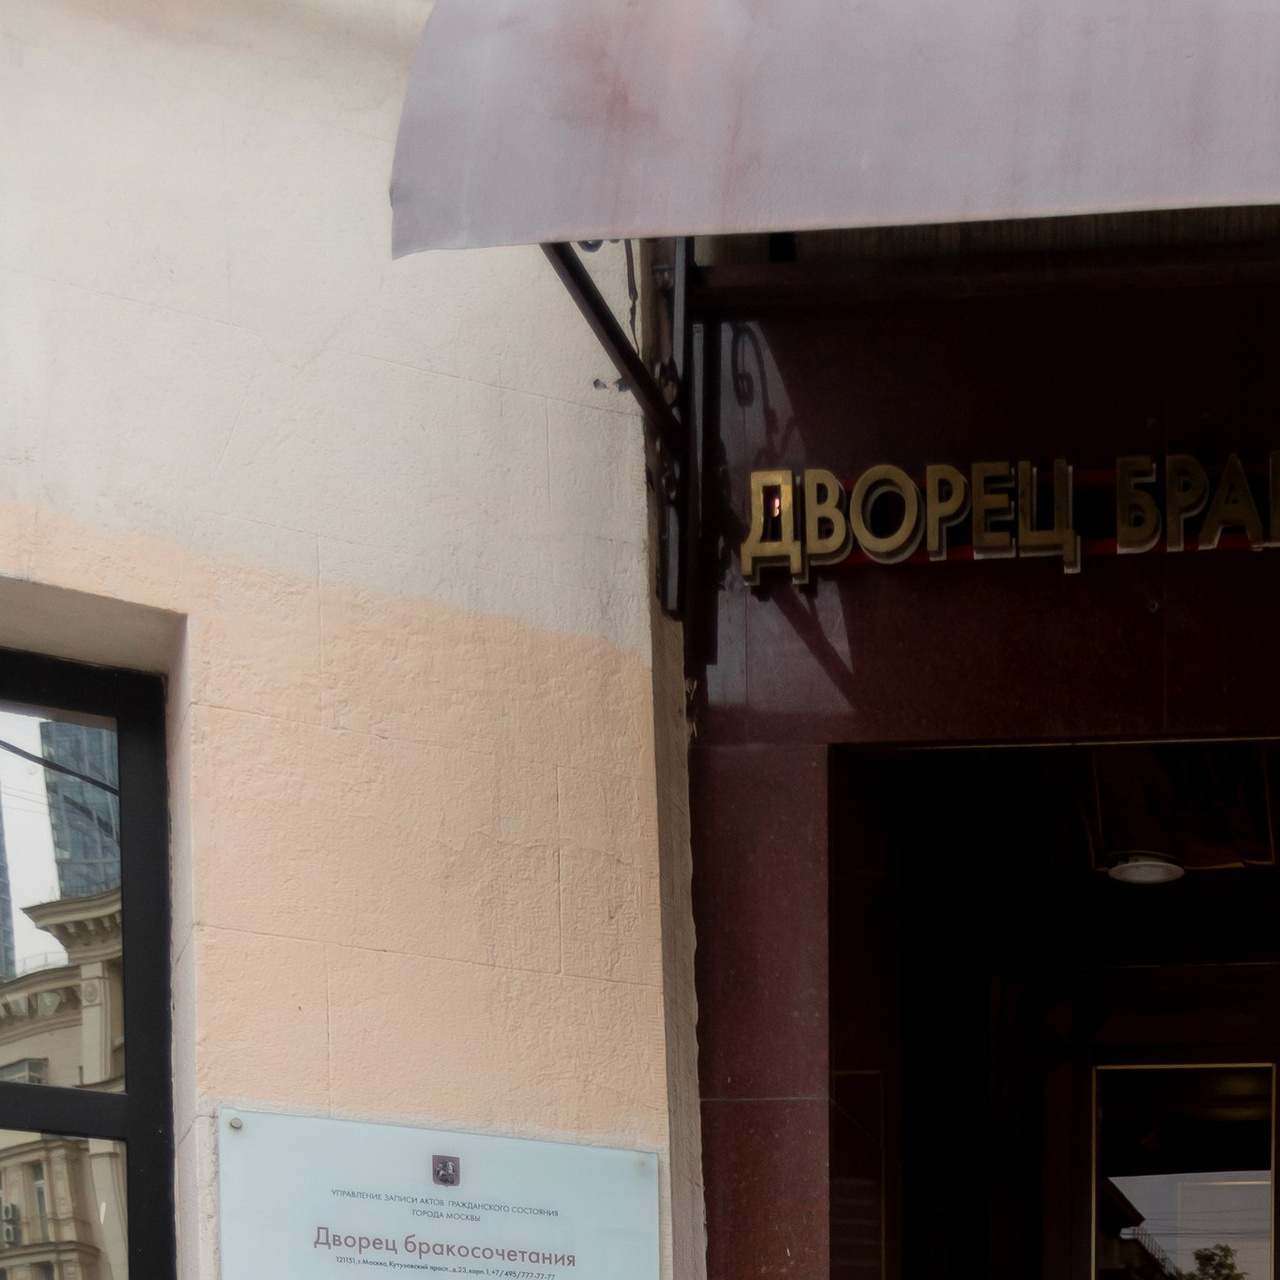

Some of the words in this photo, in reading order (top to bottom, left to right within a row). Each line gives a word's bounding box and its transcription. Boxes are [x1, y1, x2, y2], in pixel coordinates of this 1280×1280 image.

[740, 459, 1081, 586] ДВОРЕЦ
[331, 1189, 382, 1201] УПРАВЛЕНИЕ
[384, 1194, 418, 1204] ЗАПИСИ
[420, 1197, 445, 1207] АКТОВ
[448, 1200, 510, 1213] ГРАЖДАНСКОГО
[511, 1206, 559, 1218] СОСТОЯНИЯ
[412, 1209, 444, 1219] ГОРОДА
[446, 1212, 481, 1222] МОСКВЫ
[313, 1226, 398, 1255] Дворец
[404, 1233, 576, 1268] бракосочетания
